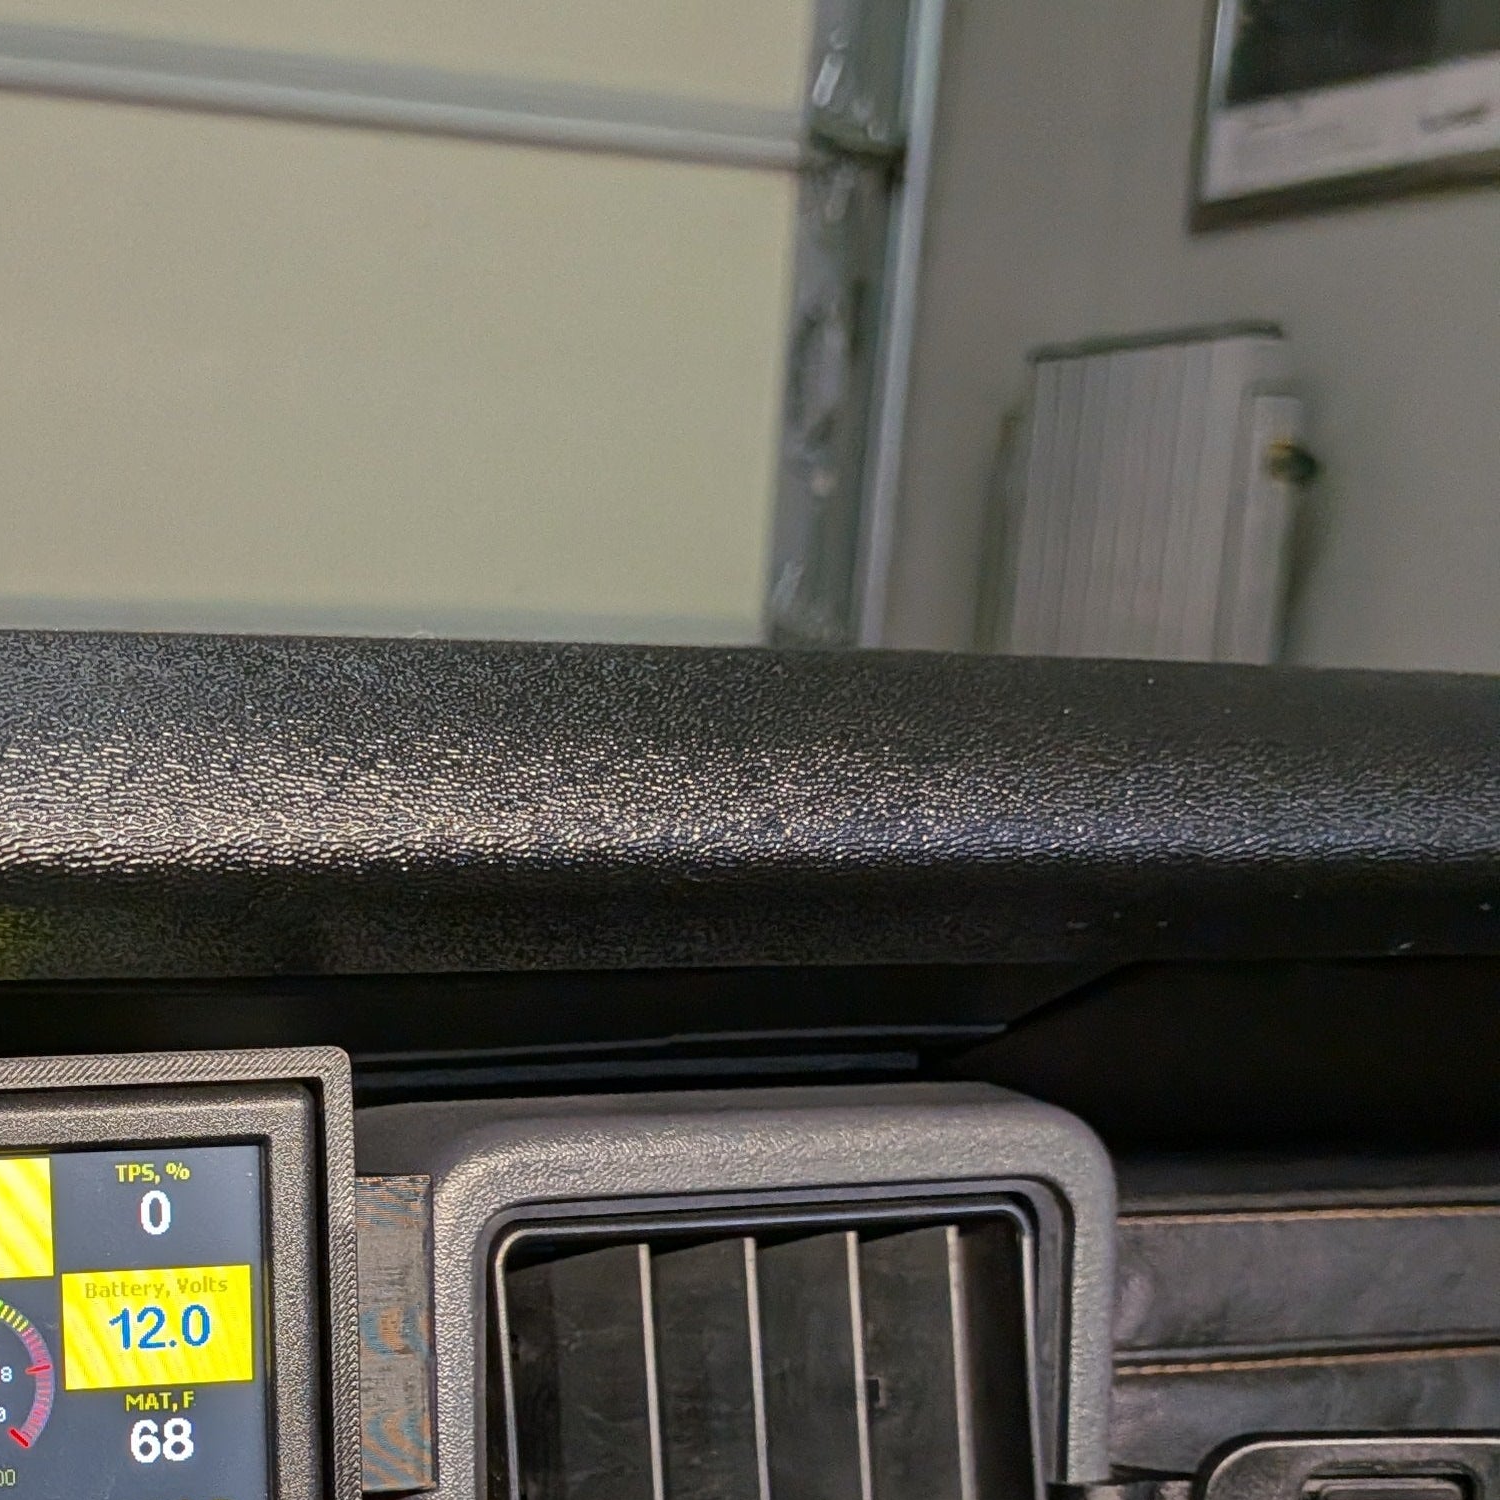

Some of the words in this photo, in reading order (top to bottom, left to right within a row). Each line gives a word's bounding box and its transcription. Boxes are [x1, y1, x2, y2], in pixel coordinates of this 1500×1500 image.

[114, 1163, 161, 1184] TPS,
[165, 1161, 191, 1180] %
[140, 1189, 172, 1236] 0
[84, 1280, 171, 1299] Battery,
[176, 1276, 229, 1294] Volts
[108, 1304, 211, 1350] 12.0
[0, 1366, 13, 1382] 8
[125, 1392, 178, 1413] MAT,
[183, 1390, 195, 1408] F
[130, 1417, 195, 1464] 68
